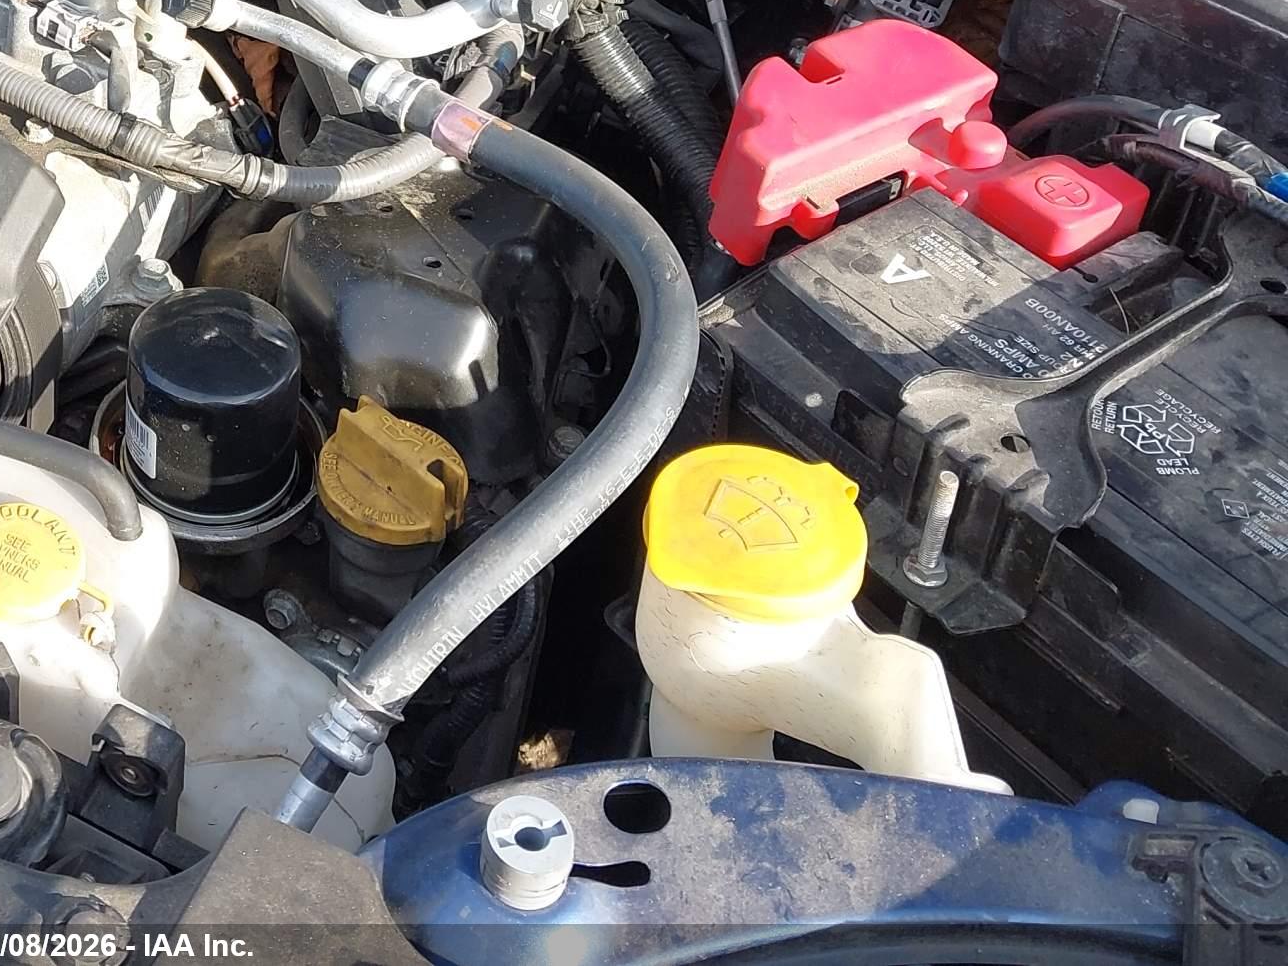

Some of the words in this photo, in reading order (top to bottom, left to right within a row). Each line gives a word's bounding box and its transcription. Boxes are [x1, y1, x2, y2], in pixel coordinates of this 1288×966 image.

[938, 313, 970, 334] AMPS
[1025, 298, 1108, 354] 2110AN00B
[967, 334, 1024, 374] CRANKING
[994, 338, 1040, 368] AMPS
[1014, 335, 1040, 354] SIZE
[1038, 353, 1072, 376] ROUP
[1105, 401, 1118, 434] RETURN
[1144, 422, 1168, 440] Pb
[1155, 467, 1200, 475] PLOMB
[1157, 458, 1190, 466] LEAD
[4, 533, 32, 552] SEE
